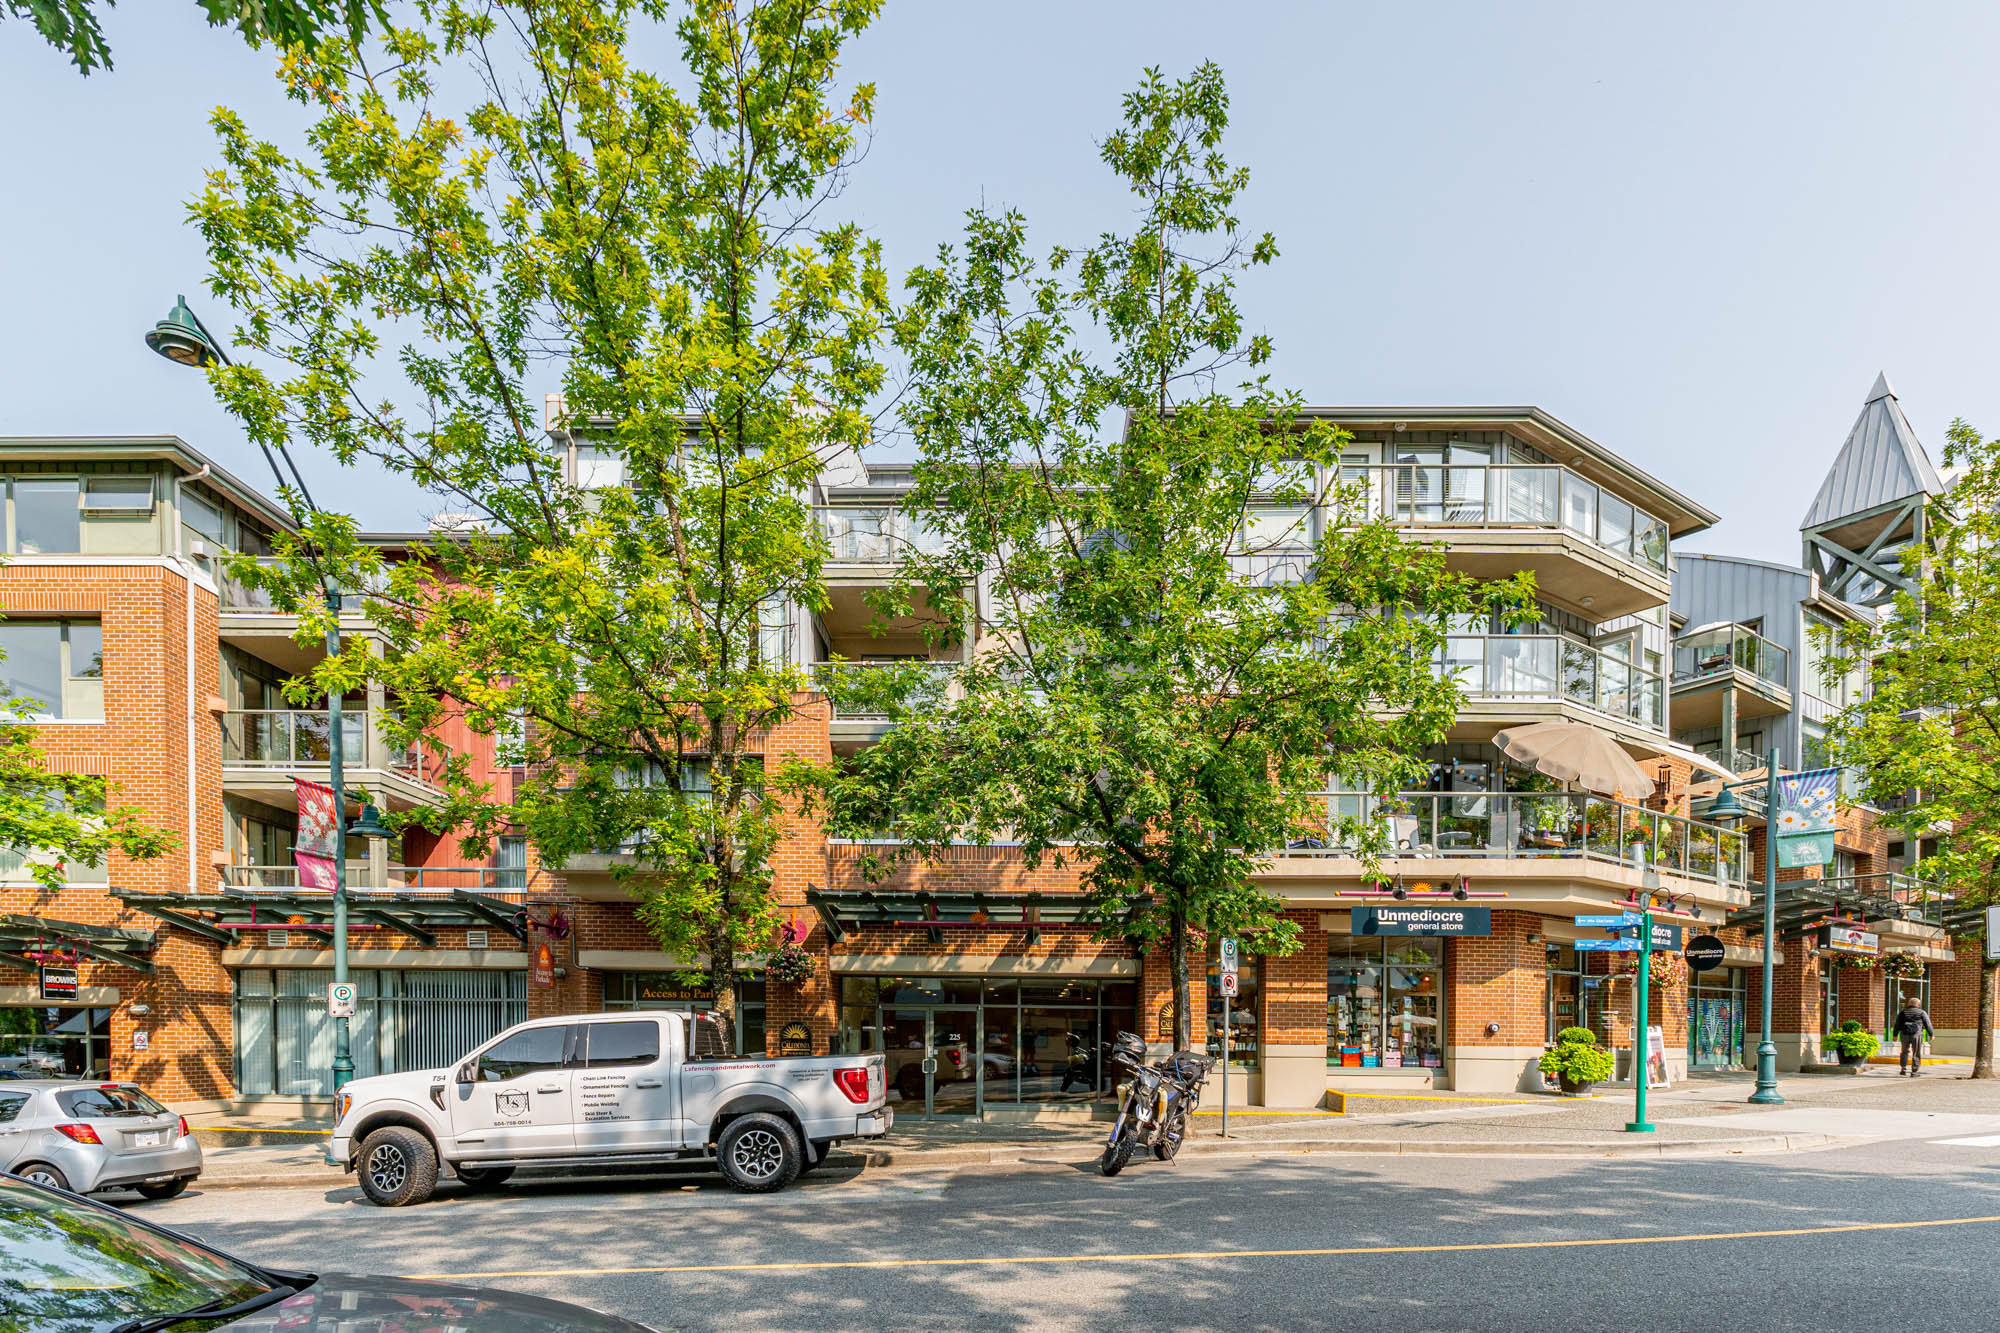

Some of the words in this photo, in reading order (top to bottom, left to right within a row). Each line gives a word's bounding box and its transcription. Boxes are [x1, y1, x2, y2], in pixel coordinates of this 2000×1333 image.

[1377, 909, 1464, 922] Unmediocre
[1407, 922, 1440, 931] general
[1441, 922, 1464, 930] store
[45, 975, 77, 985] BROWNS
[340, 989, 347, 997] P
[642, 986, 678, 998] Access
[680, 989, 691, 998] to
[949, 1033, 961, 1041] 225
